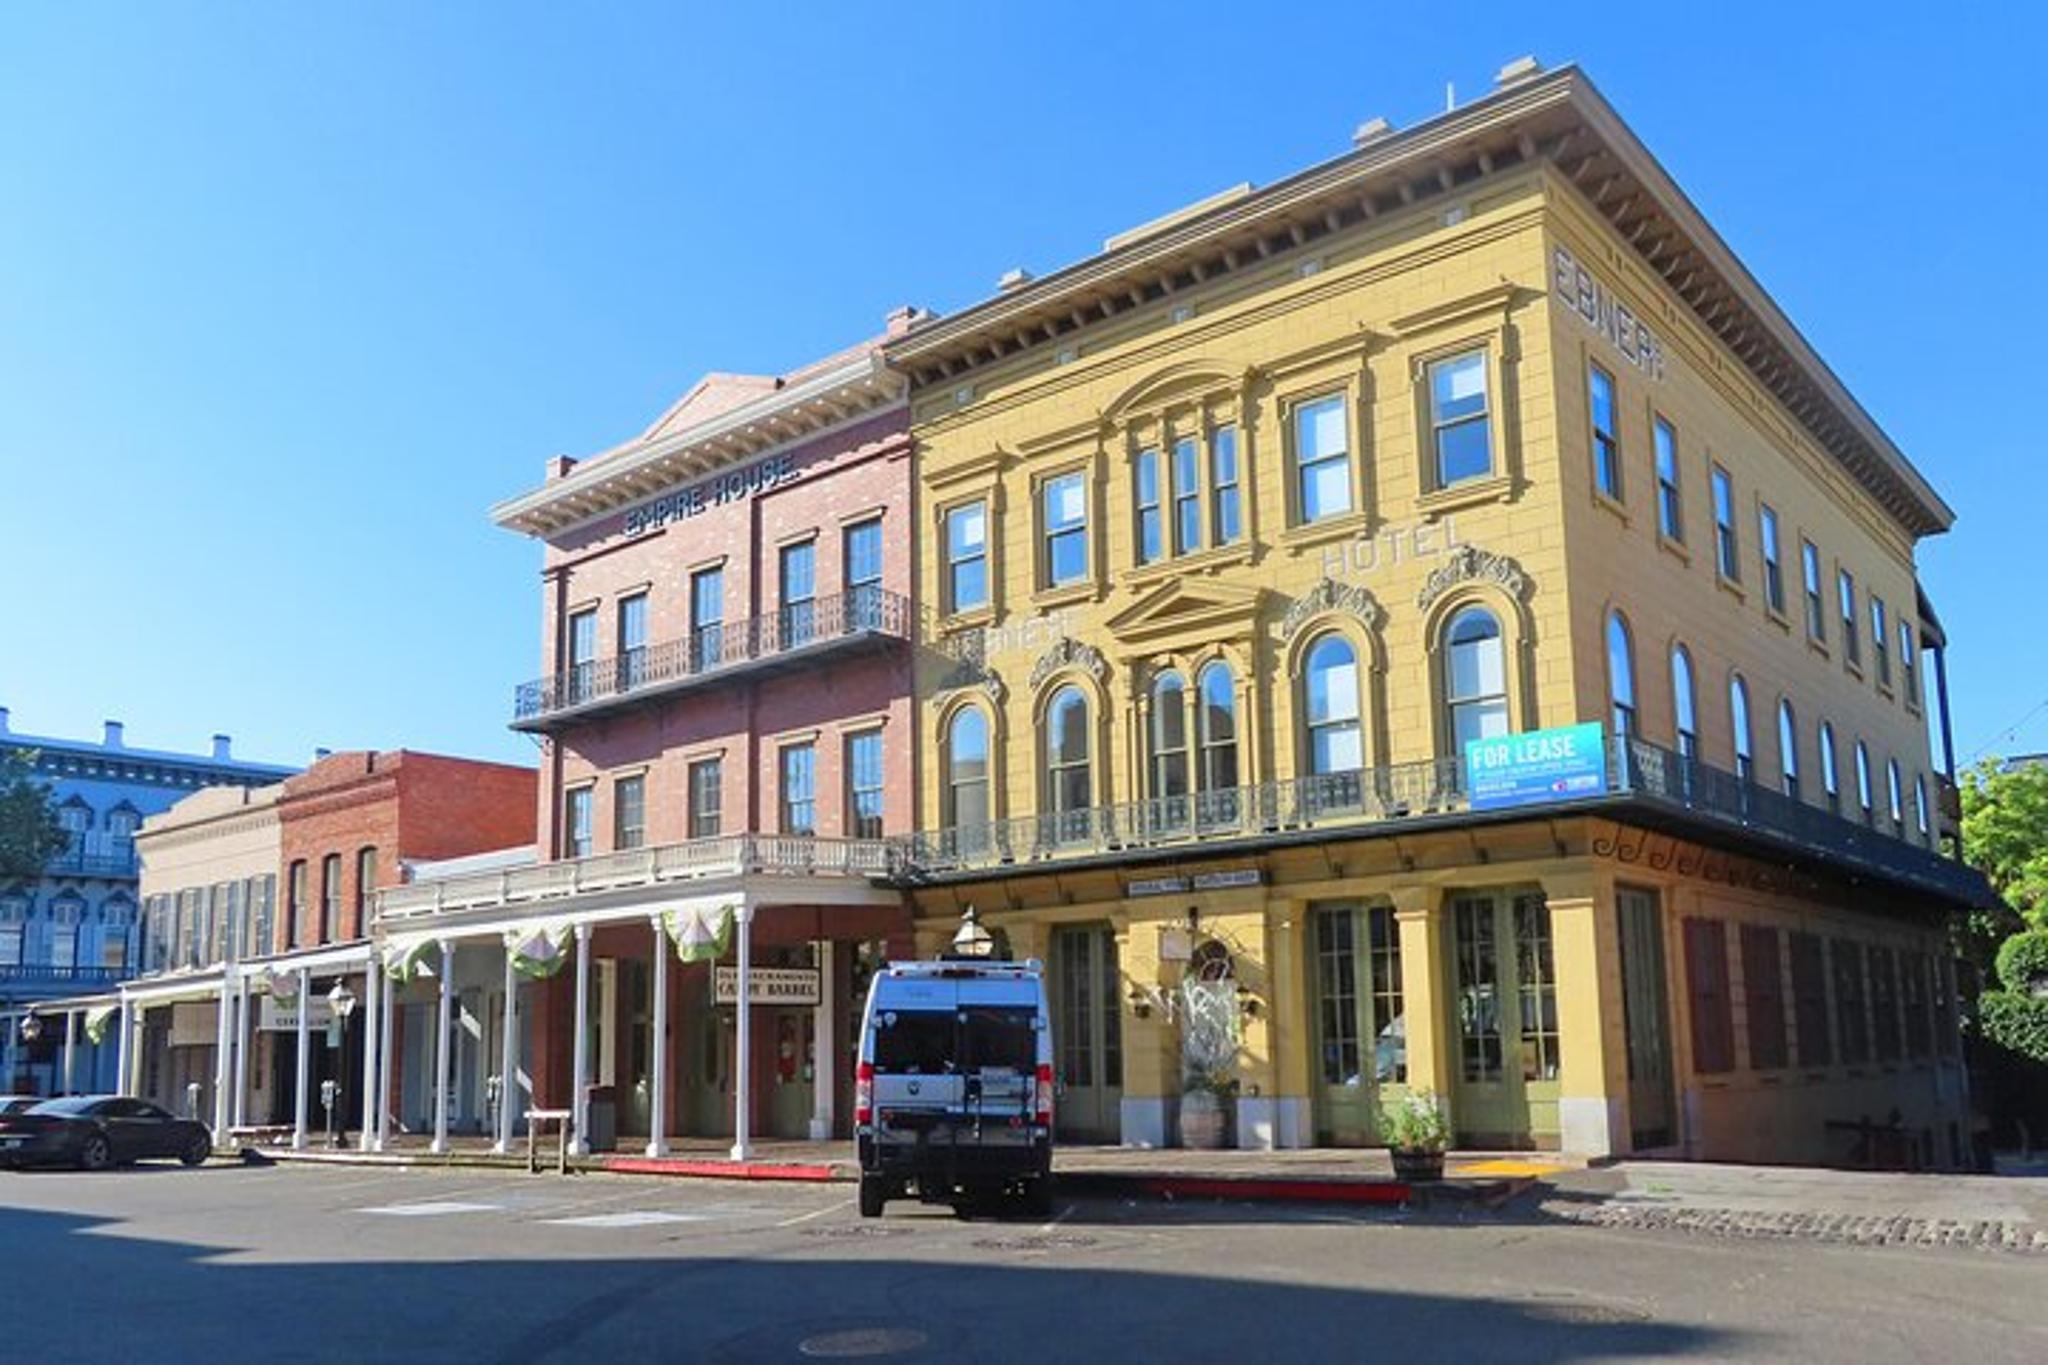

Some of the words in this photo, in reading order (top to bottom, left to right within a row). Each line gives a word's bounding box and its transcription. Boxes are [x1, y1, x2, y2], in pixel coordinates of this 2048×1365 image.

[622, 487, 706, 538] EMPIRE
[714, 454, 800, 507] HOUSE
[1323, 514, 1464, 578] HOTEL
[1472, 743, 1511, 769] FOR
[1516, 733, 1576, 763] LEASE
[719, 983, 762, 996] CAY
[767, 984, 817, 996] BARREL
